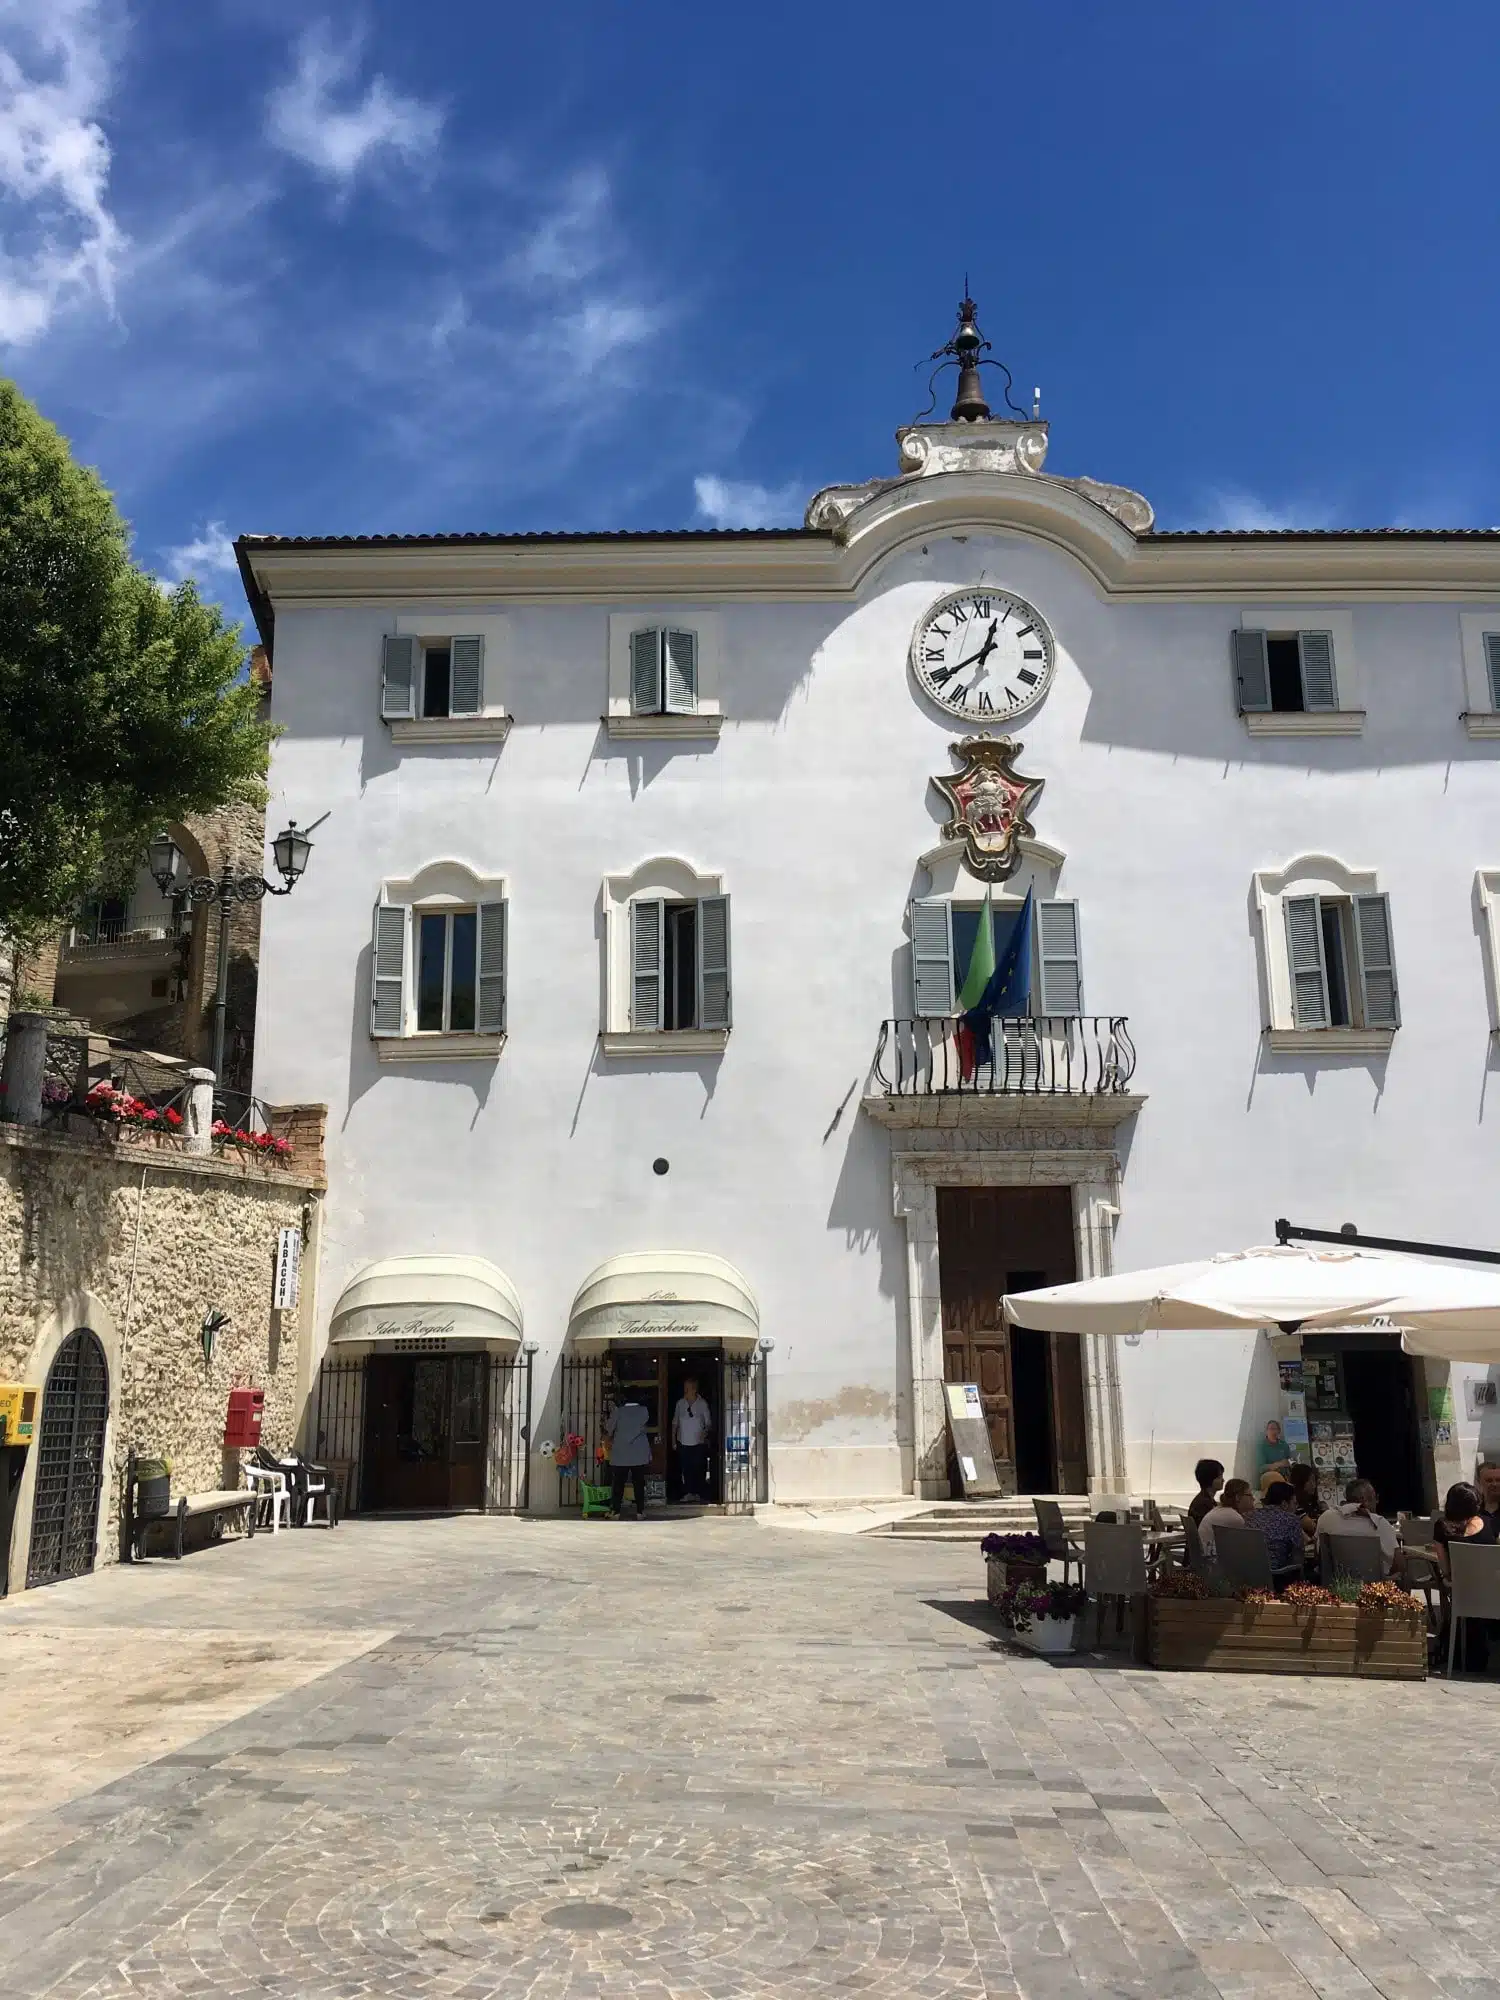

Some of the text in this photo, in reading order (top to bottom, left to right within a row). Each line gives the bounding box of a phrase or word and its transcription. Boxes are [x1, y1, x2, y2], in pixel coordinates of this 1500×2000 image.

[947, 605, 968, 626] XI
[973, 600, 991, 619] XII
[1002, 607, 1013, 623] I
[930, 623, 951, 640] X
[1016, 625, 1035, 638] II
[925, 648, 944, 661] IX
[1023, 650, 1042, 659] III
[1017, 668, 1038, 686] IIII
[949, 684, 968, 706] VII
[979, 692, 993, 709] VI
[1004, 686, 1020, 704] V
[279, 1230, 290, 1307] TABACCHI
[368, 1319, 455, 1338] Idee Regalo
[617, 1320, 699, 1334] Tabaccheria
